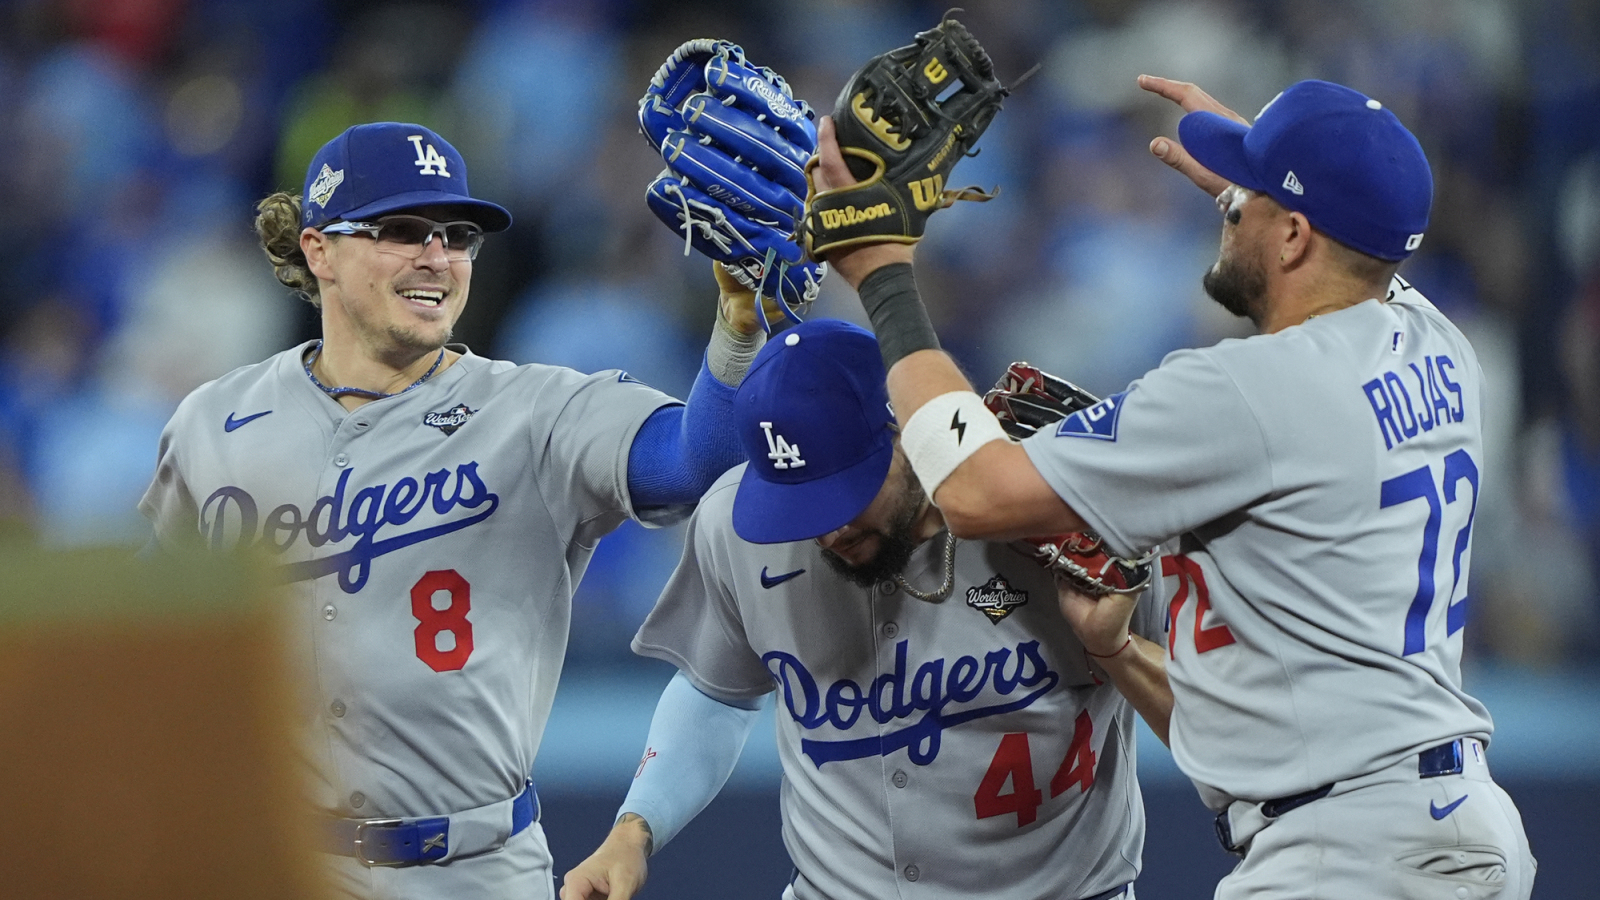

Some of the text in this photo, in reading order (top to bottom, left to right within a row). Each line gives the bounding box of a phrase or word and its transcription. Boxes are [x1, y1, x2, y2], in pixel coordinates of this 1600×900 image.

[407, 135, 451, 178] LA
[819, 202, 892, 230] Wilson
[760, 421, 806, 469] LA
[1362, 355, 1465, 451] ROJAS
[201, 461, 499, 594] Dodgers
[1380, 448, 1479, 657] 72
[410, 569, 474, 673] 8
[968, 588, 1026, 608] World Series
[1161, 553, 1237, 660] 72
[762, 639, 1059, 769] Dodgers
[974, 709, 1096, 828] 44
